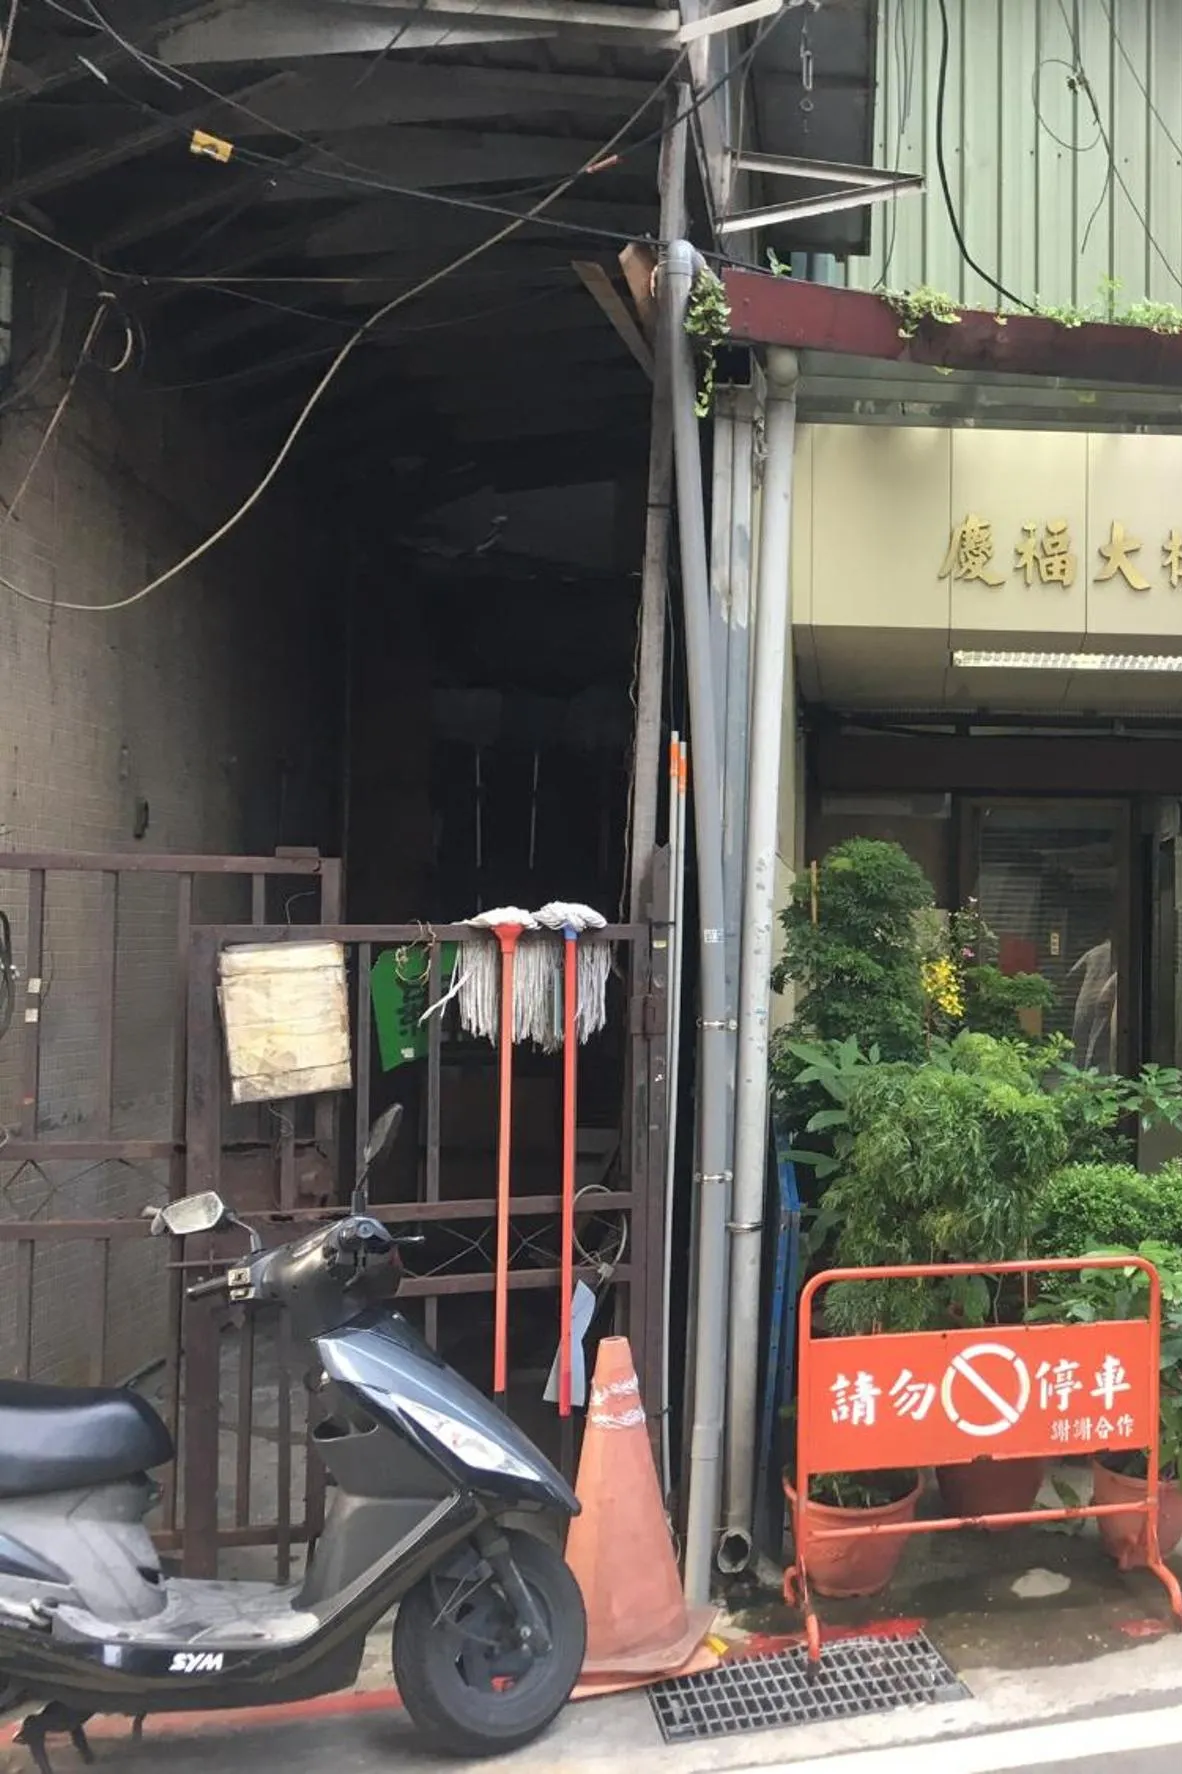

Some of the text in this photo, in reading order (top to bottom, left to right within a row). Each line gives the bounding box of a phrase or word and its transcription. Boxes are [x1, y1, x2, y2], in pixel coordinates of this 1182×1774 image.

[829, 1354, 1132, 1427] 請勿 停車
[168, 1652, 224, 1673] SYM
